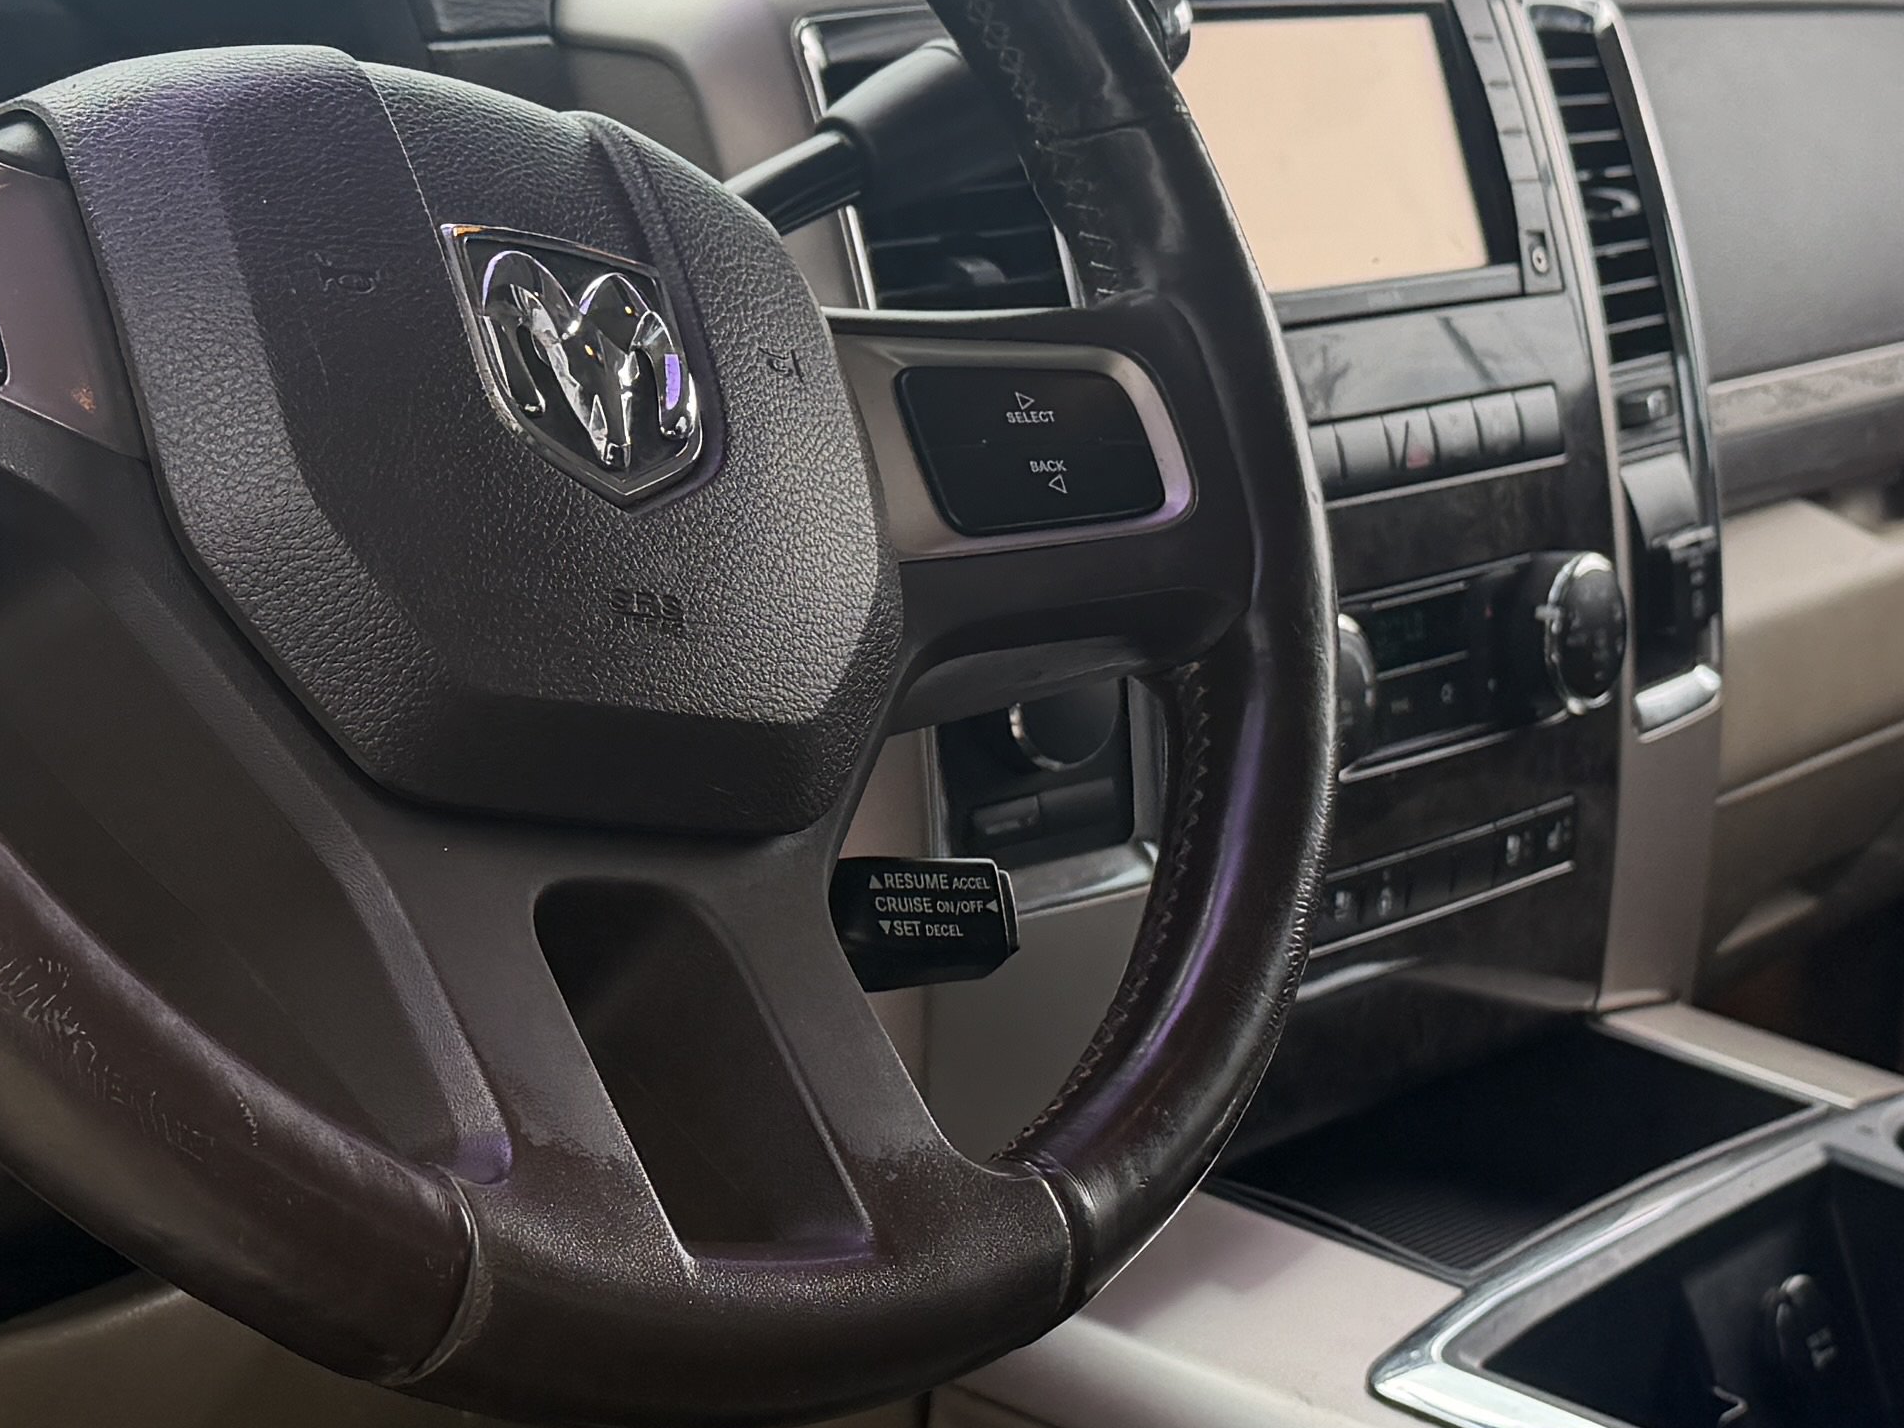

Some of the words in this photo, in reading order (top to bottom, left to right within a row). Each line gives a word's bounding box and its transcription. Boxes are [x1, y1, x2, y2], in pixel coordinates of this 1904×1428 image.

[1006, 410, 1056, 424] SELECT
[1029, 459, 1068, 473] BACK
[884, 873, 949, 890] RESUME
[952, 876, 991, 890] ACCEL
[874, 896, 933, 914] CRUISE
[936, 900, 984, 915] ON/OFF
[894, 920, 921, 937] SET
[925, 924, 964, 937] DECEL
